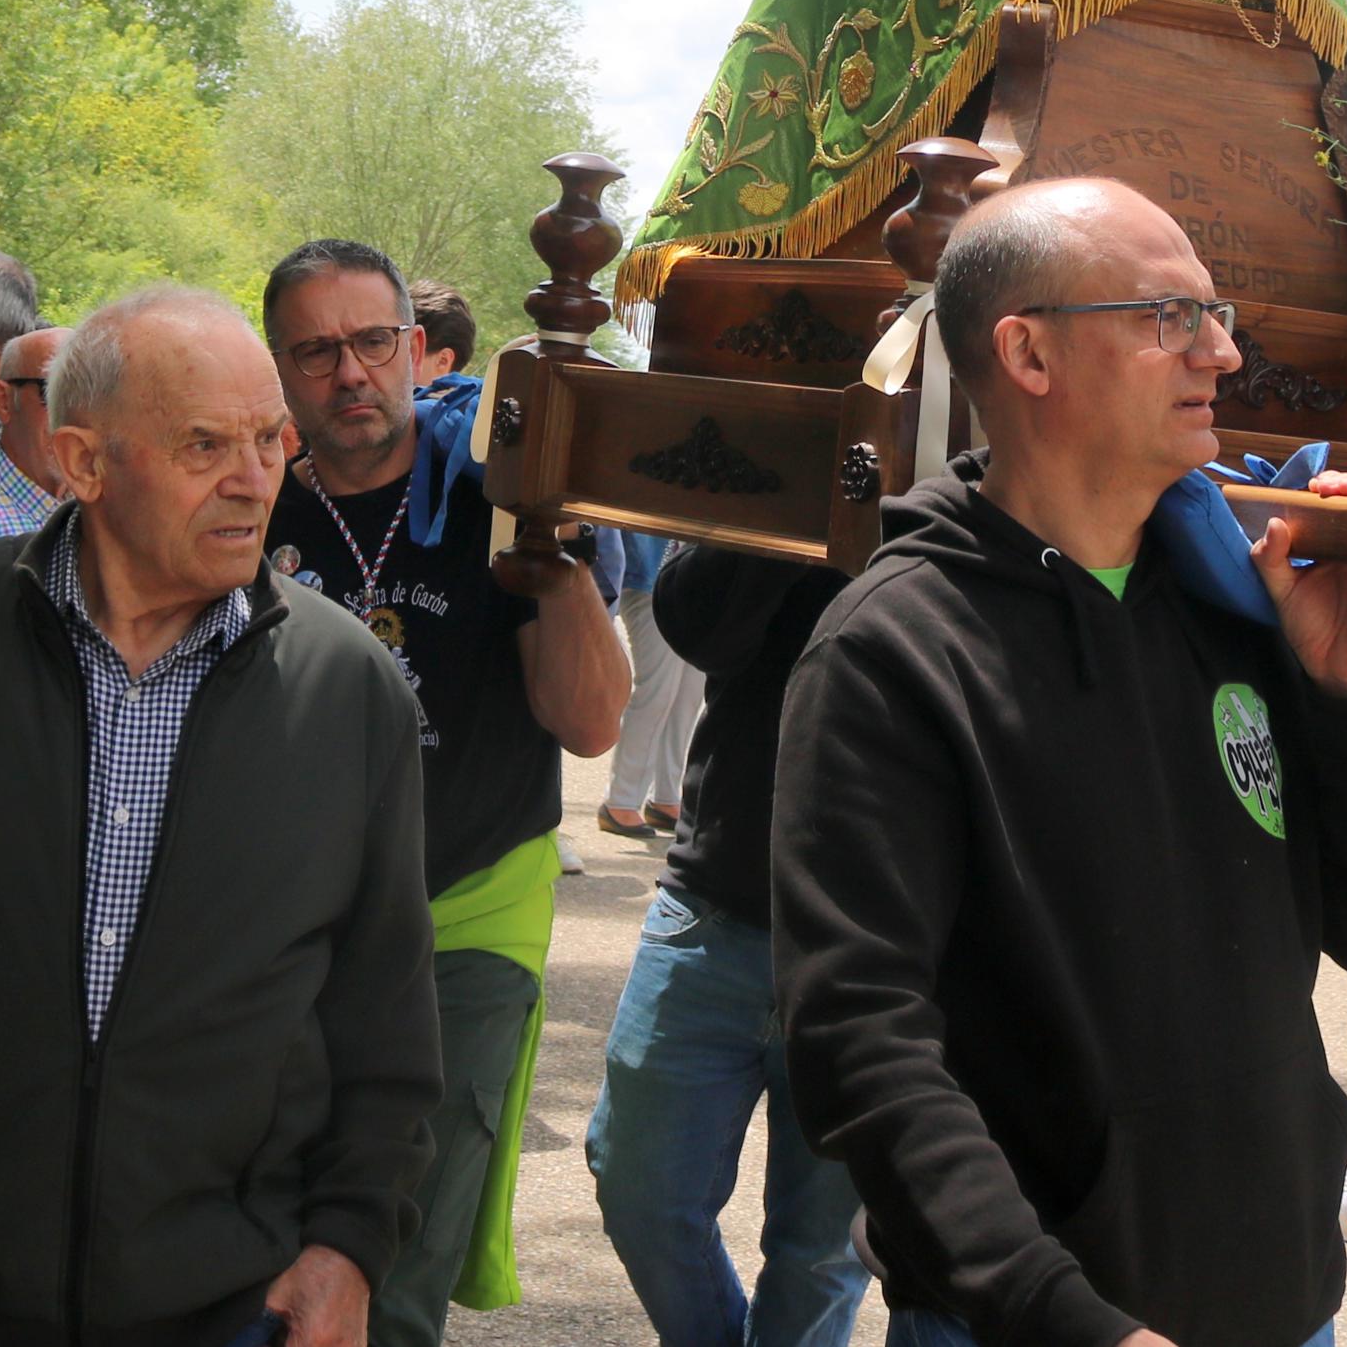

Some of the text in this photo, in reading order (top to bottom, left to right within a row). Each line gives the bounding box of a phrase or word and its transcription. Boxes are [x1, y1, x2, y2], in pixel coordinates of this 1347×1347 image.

[1169, 171, 1212, 206] DE
[392, 581, 406, 604] de
[411, 582, 449, 616] Garón
